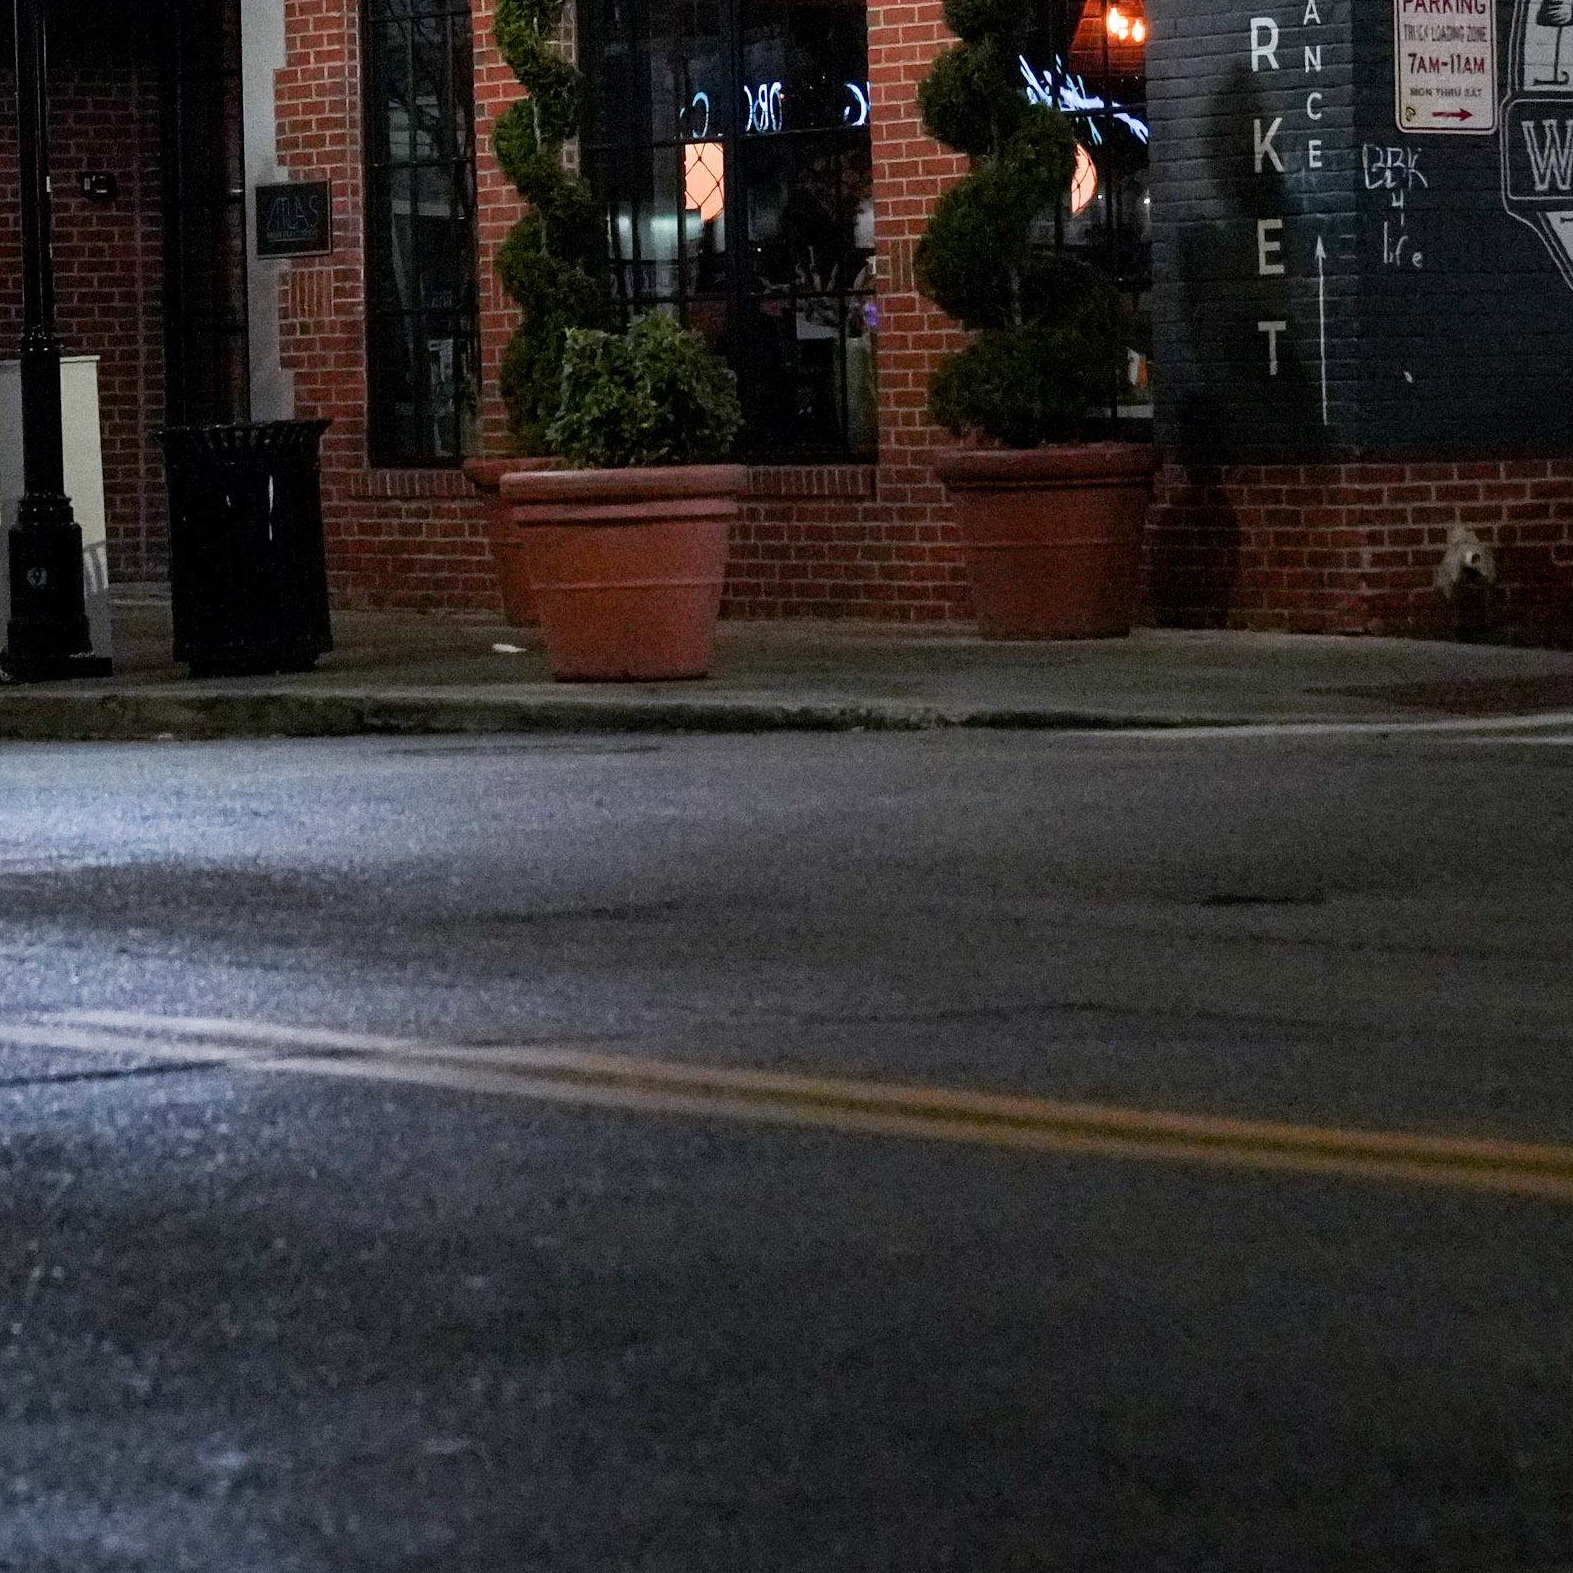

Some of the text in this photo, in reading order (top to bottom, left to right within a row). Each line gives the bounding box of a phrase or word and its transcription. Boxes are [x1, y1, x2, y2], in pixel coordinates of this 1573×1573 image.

[1408, 53, 1485, 75] 7AM-11AM
[1410, 88, 1433, 97] MON
[1436, 88, 1462, 97] THRU
